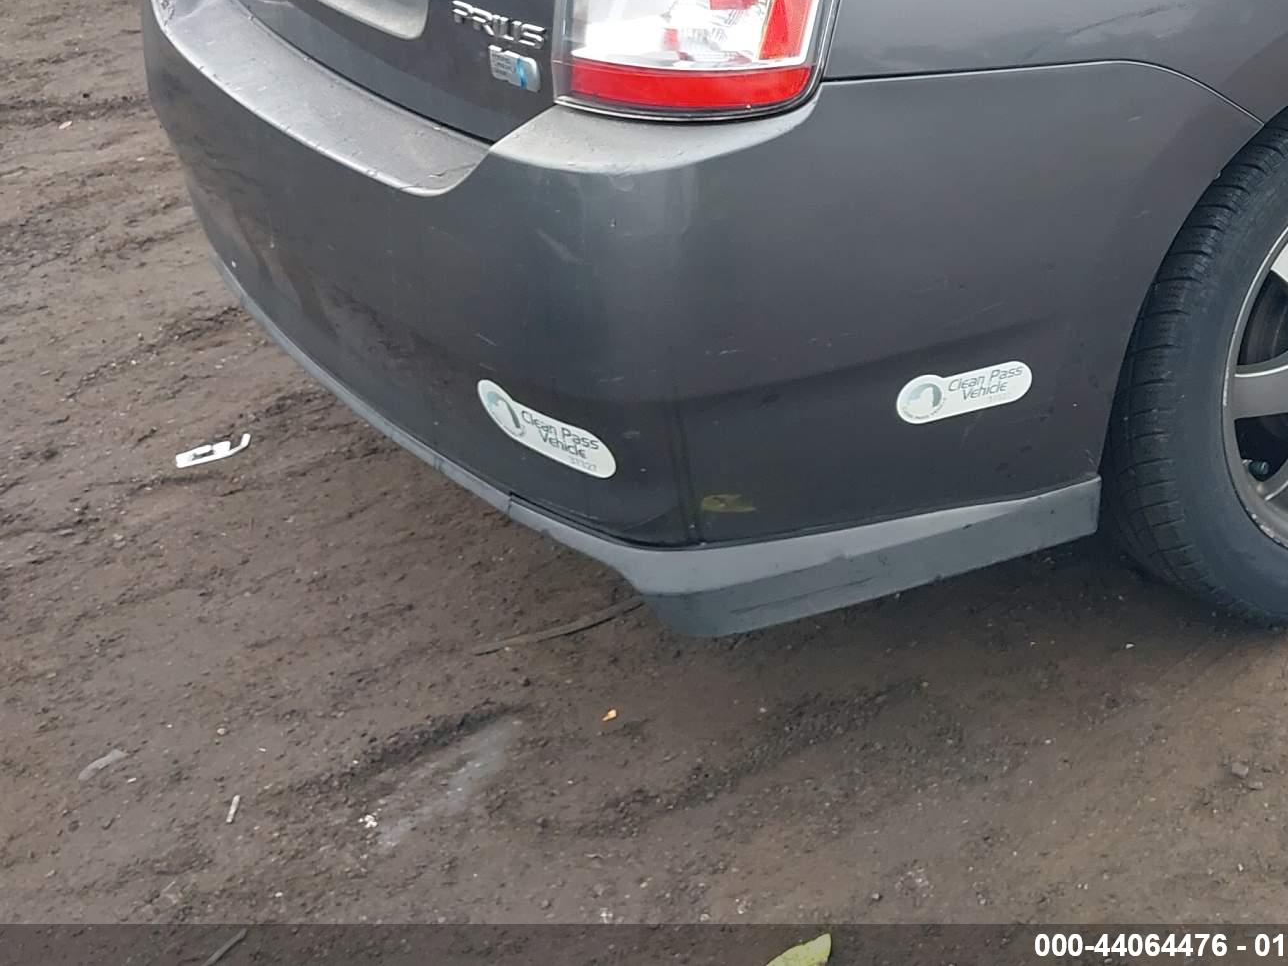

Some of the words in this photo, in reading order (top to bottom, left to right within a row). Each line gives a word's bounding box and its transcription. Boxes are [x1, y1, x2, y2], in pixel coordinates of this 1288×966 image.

[452, 0, 545, 50] PRIUS
[948, 375, 985, 392] Clean
[990, 366, 1024, 382] Pass
[962, 381, 1008, 401] Vehicle
[521, 410, 558, 437] Clean
[561, 427, 600, 450] Pass
[540, 429, 588, 459] Vehicle
